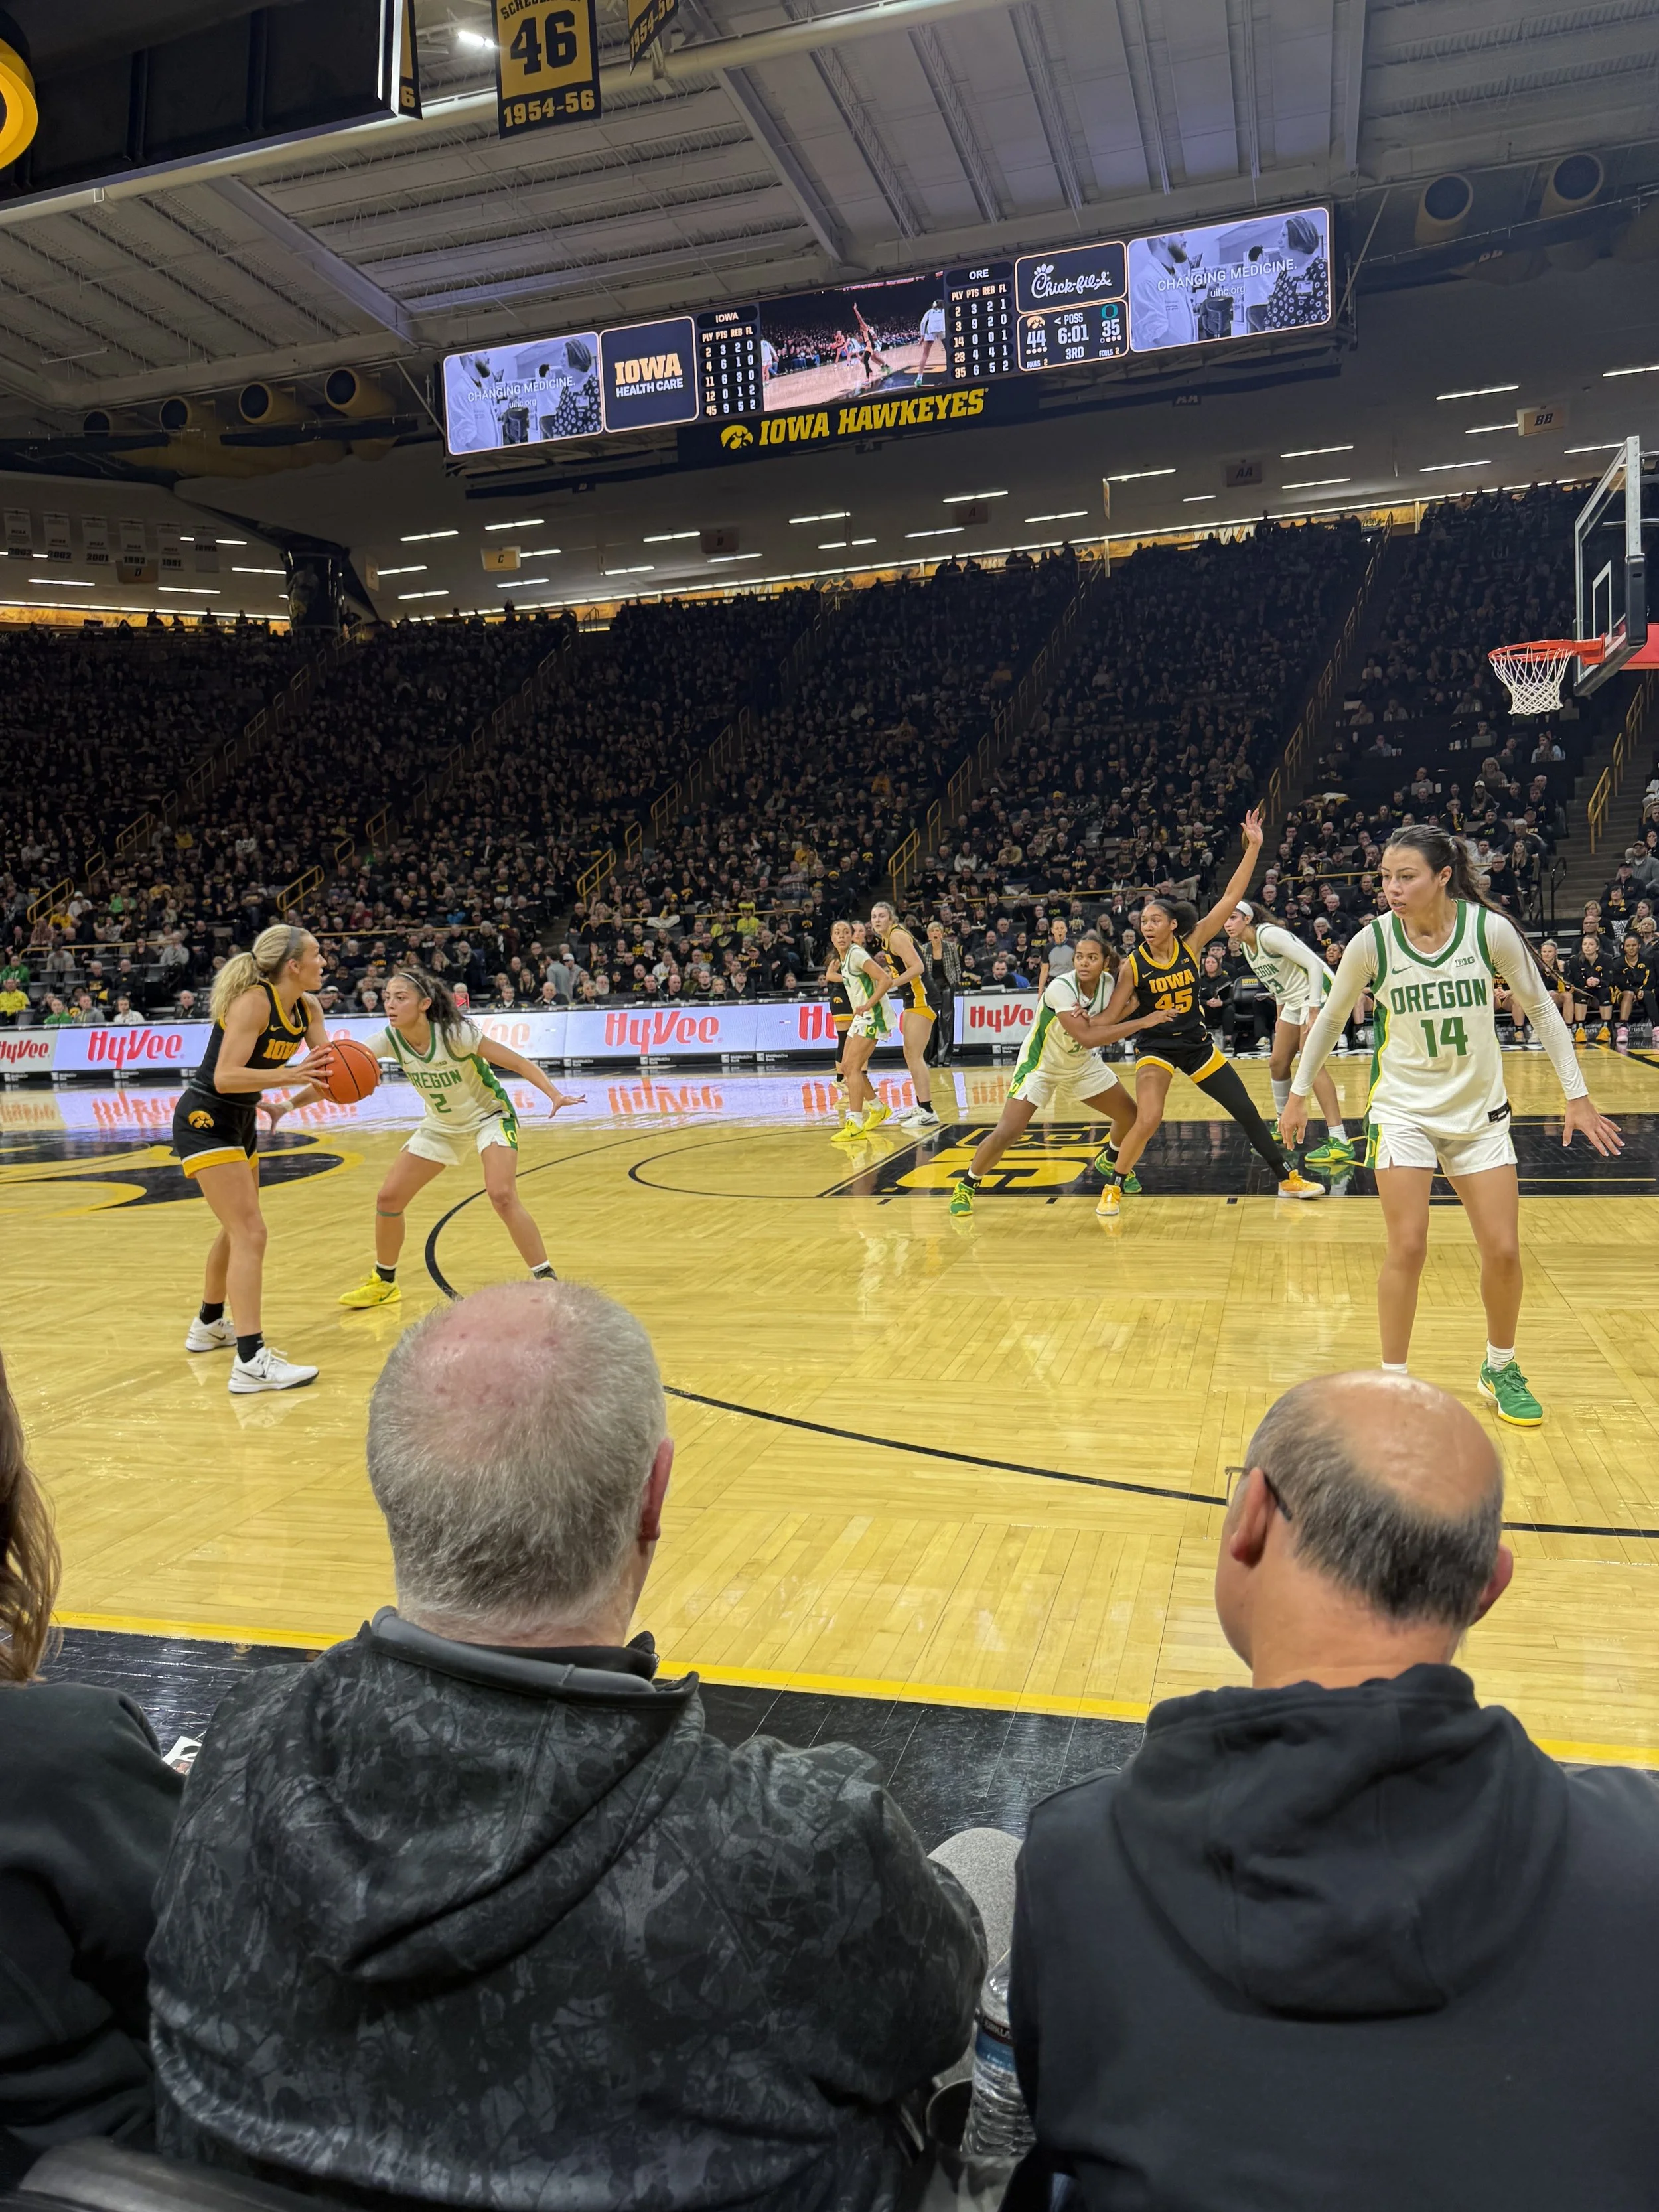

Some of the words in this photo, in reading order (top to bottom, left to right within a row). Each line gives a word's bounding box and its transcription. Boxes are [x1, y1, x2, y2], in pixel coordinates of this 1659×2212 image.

[510, 9, 577, 76] 46
[504, 88, 595, 128] 1954-56
[969, 269, 989, 280] ORE
[1157, 270, 1226, 291] CHANGING
[1230, 259, 1297, 279] MEDICINE.
[952, 291, 963, 301] PLY
[966, 289, 979, 299] PTS
[982, 285, 995, 295] REB
[999, 284, 1007, 293] FL
[1210, 285, 1246, 298] uihc.org
[715, 312, 739, 323] IOWA
[955, 306, 961, 317] 2
[971, 303, 977, 314] 3
[987, 301, 993, 311] 2
[1001, 299, 1006, 310] 1
[956, 321, 962, 332] 3
[972, 319, 977, 329] 9
[987, 316, 993, 327] 2
[1001, 313, 1007, 325] 0
[1064, 313, 1084, 325] POSS
[1102, 318, 1120, 337] 35
[702, 332, 713, 342] PLY
[715, 331, 727, 340] PTS
[731, 328, 743, 338] REB
[745, 327, 753, 335] FL
[954, 336, 964, 348] 14
[972, 334, 978, 345] 0
[988, 331, 994, 342] 0
[1002, 329, 1007, 340] 1
[1027, 329, 1046, 348] 44
[1058, 324, 1089, 344] 6:01
[705, 347, 711, 358] 2
[720, 344, 726, 355] 3
[735, 342, 741, 353] 2
[747, 340, 753, 351] 0
[954, 352, 966, 363] 23
[972, 349, 979, 360] 4
[989, 346, 995, 358] 4
[1002, 344, 1008, 356] 1
[1065, 346, 1084, 360] 3RD
[1099, 348, 1113, 357] FOULS
[614, 353, 683, 385] IOWA
[705, 361, 712, 372] 4
[721, 358, 727, 370] 6
[735, 356, 741, 367] 1
[747, 354, 754, 365] 0
[955, 367, 966, 378] 35
[973, 364, 979, 376] 6
[989, 362, 995, 373] 5
[1002, 360, 1009, 372] 2
[1027, 360, 1041, 368] FOULS
[705, 376, 715, 387] 11
[721, 374, 727, 384] 6
[736, 371, 743, 382] 3
[748, 369, 755, 380] 0
[468, 384, 521, 402] CHANGING
[524, 376, 575, 393] MEDICINE.
[616, 382, 655, 398] HEALTH
[656, 378, 684, 391] CARE
[706, 390, 715, 402] 12
[722, 388, 728, 399] 0
[737, 386, 743, 397] 1
[749, 384, 755, 395] 2
[509, 398, 537, 409] uihc.org
[706, 405, 717, 416] 45
[723, 403, 729, 413] 9
[737, 401, 744, 411] 5
[750, 399, 756, 409] 2
[759, 412, 830, 446] IOWA
[837, 388, 985, 435] HAWKEYES
[1534, 413, 1553, 426] BB
[1236, 467, 1253, 479] AA
[1149, 969, 1195, 994] IOWA
[1155, 987, 1193, 1014] 45
[1390, 978, 1488, 1015] OREGON
[970, 1003, 1033, 1033] HyVe
[605, 1010, 720, 1055] HyVee
[1420, 1017, 1468, 1057] 14
[87, 1029, 183, 1069] HyVee
[263, 1039, 297, 1060] IOW
[429, 1093, 453, 1114] 2
